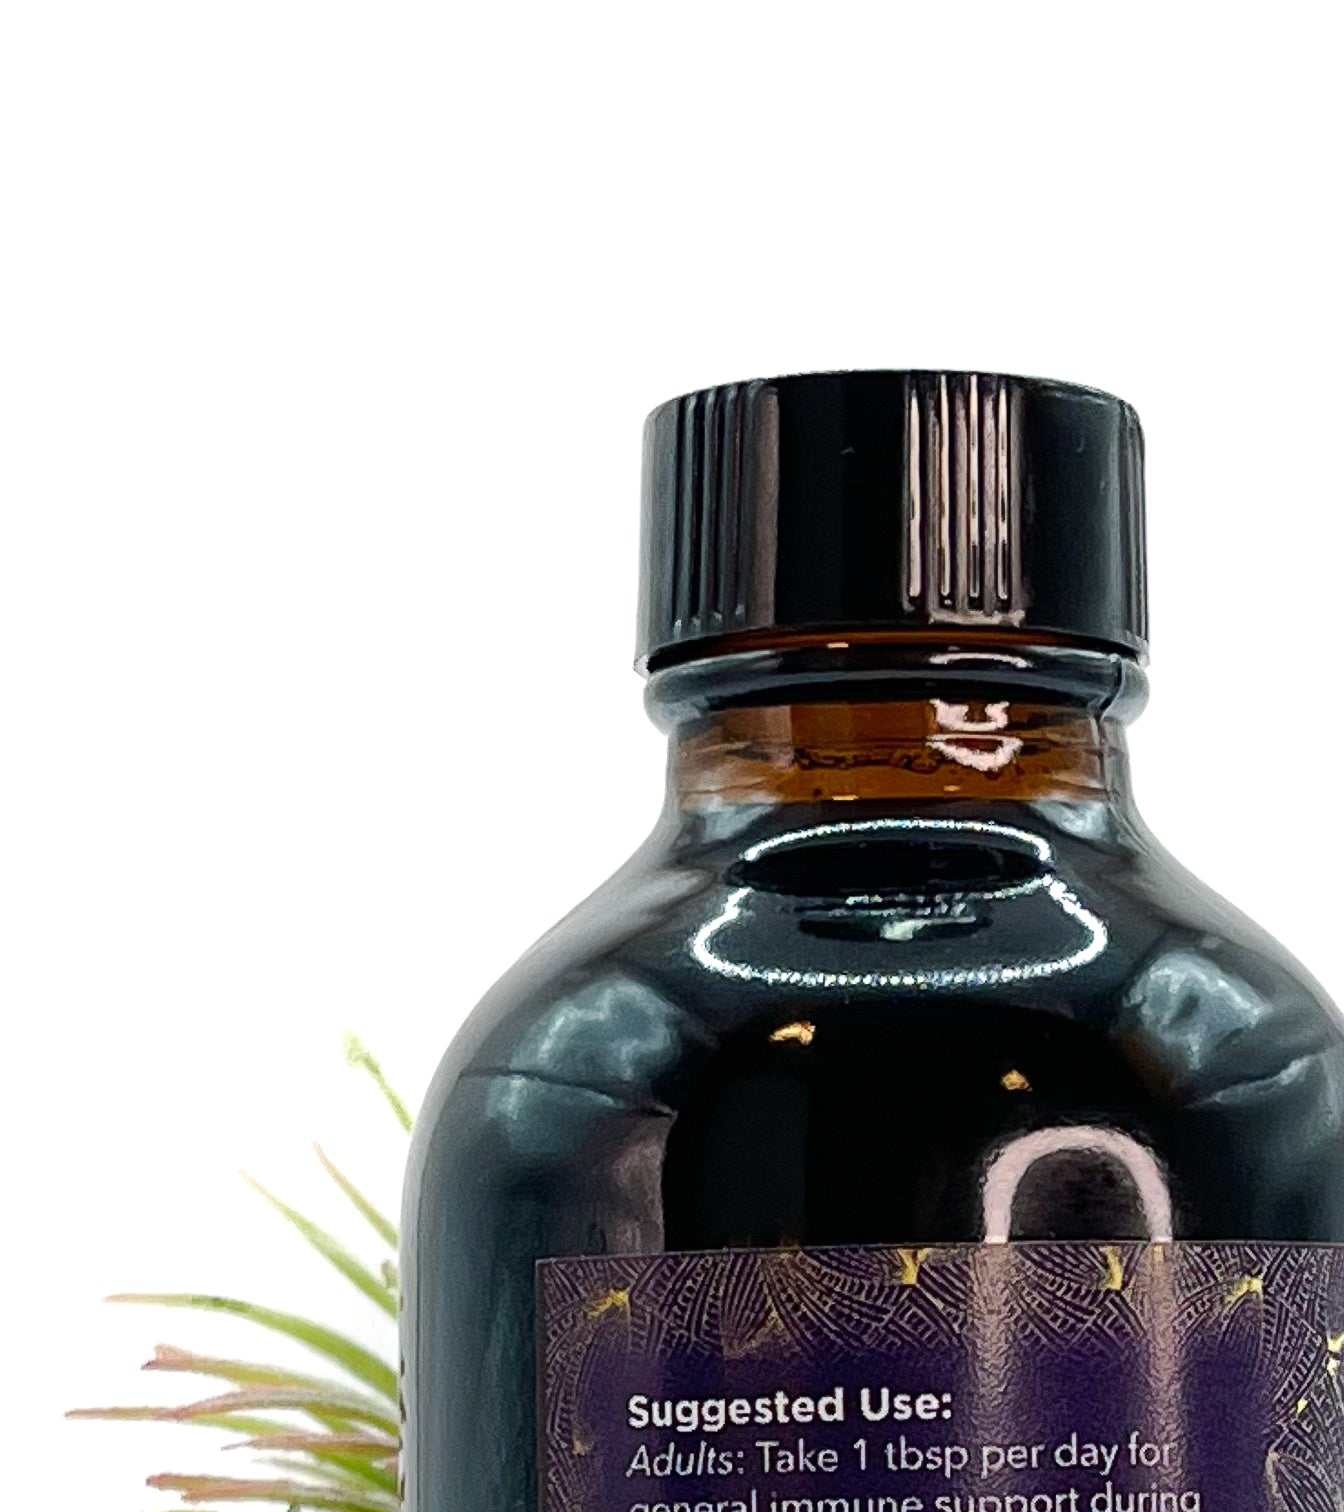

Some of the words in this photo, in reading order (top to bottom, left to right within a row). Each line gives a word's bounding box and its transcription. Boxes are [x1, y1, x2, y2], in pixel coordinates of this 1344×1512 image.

[628, 1386, 844, 1433] Suggested
[860, 1387, 952, 1421] Use:
[625, 1440, 744, 1478] Adults:
[755, 1438, 839, 1473] Take
[853, 1438, 866, 1471] 1
[885, 1435, 969, 1479] tbsp
[981, 1445, 1045, 1479] per
[1054, 1431, 1119, 1476] day
[1128, 1431, 1179, 1468] for
